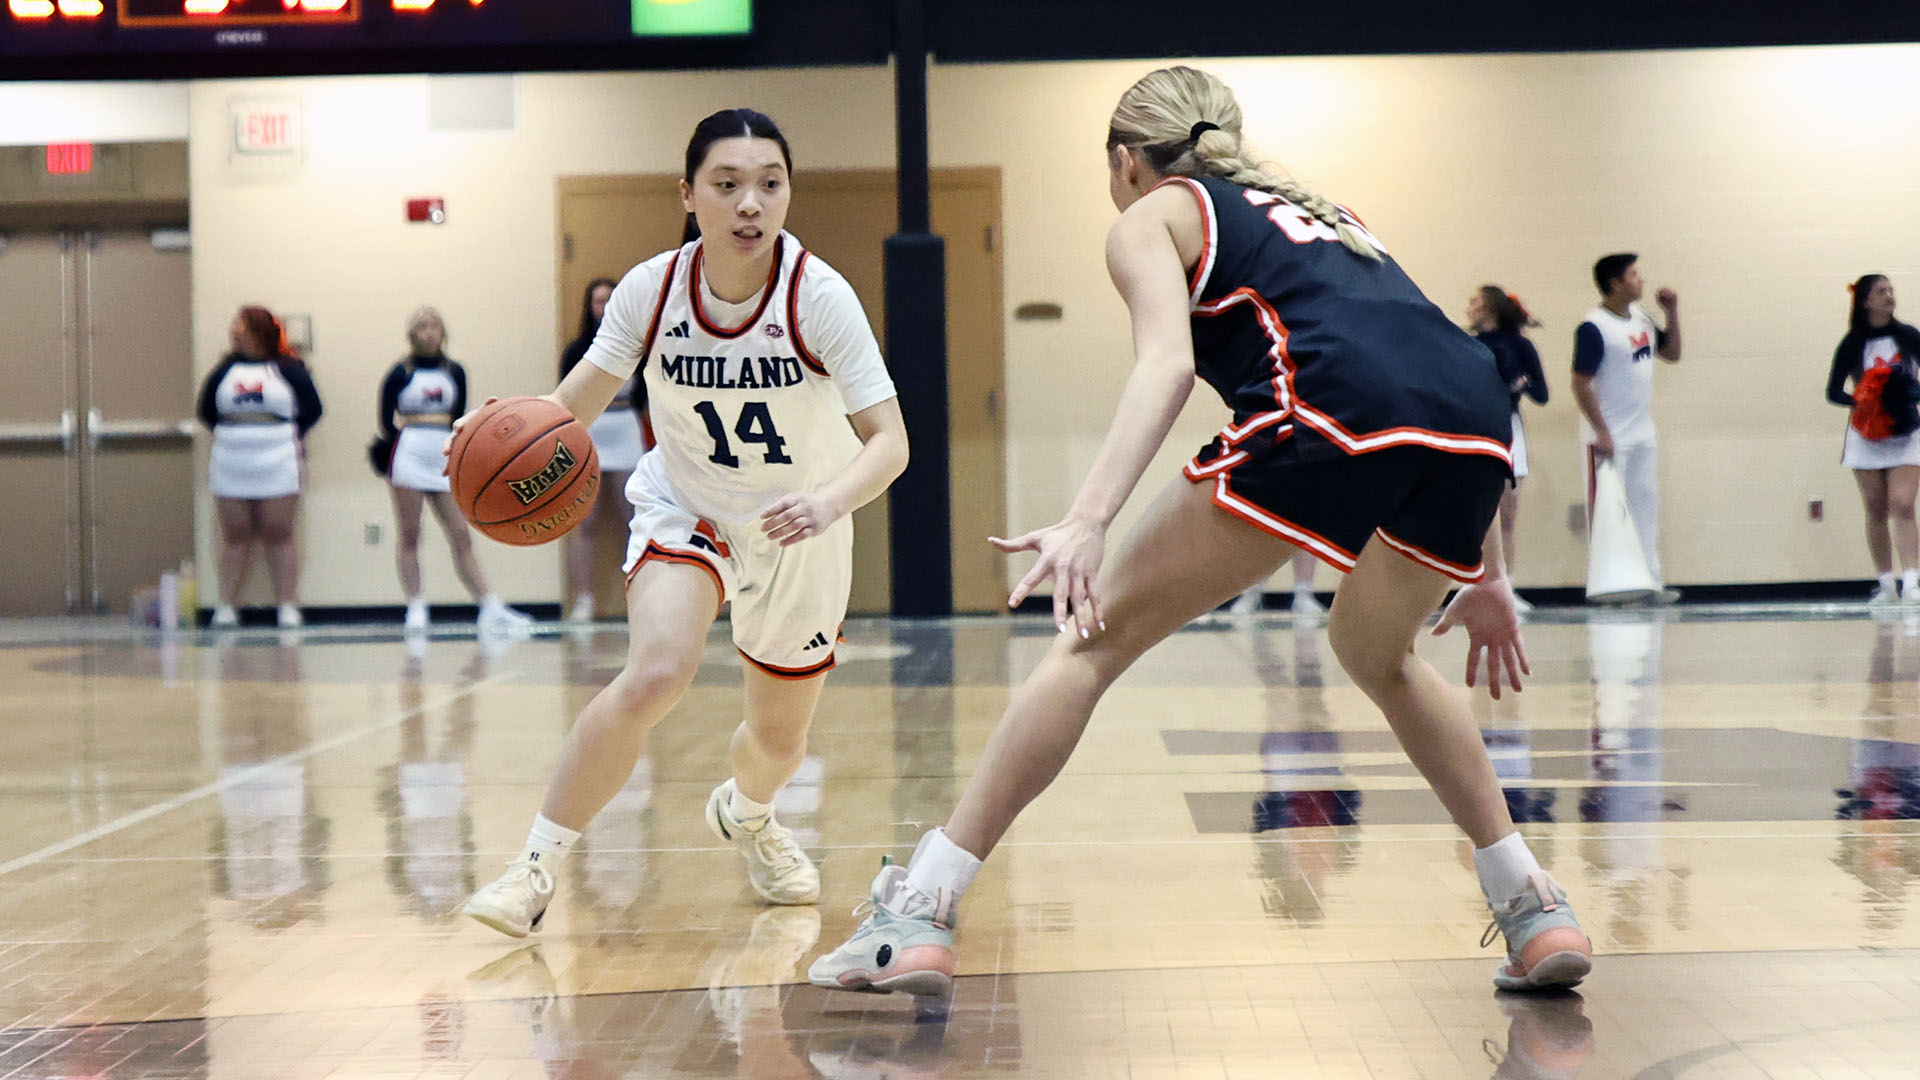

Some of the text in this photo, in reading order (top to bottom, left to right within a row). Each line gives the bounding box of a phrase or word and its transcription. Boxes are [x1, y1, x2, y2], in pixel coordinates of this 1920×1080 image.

[248, 114, 288, 146] EXIT
[48, 142, 90, 172] EXIT
[661, 353, 804, 389] MIDLAND
[693, 401, 793, 469] 14
[507, 439, 577, 505] NAIA
